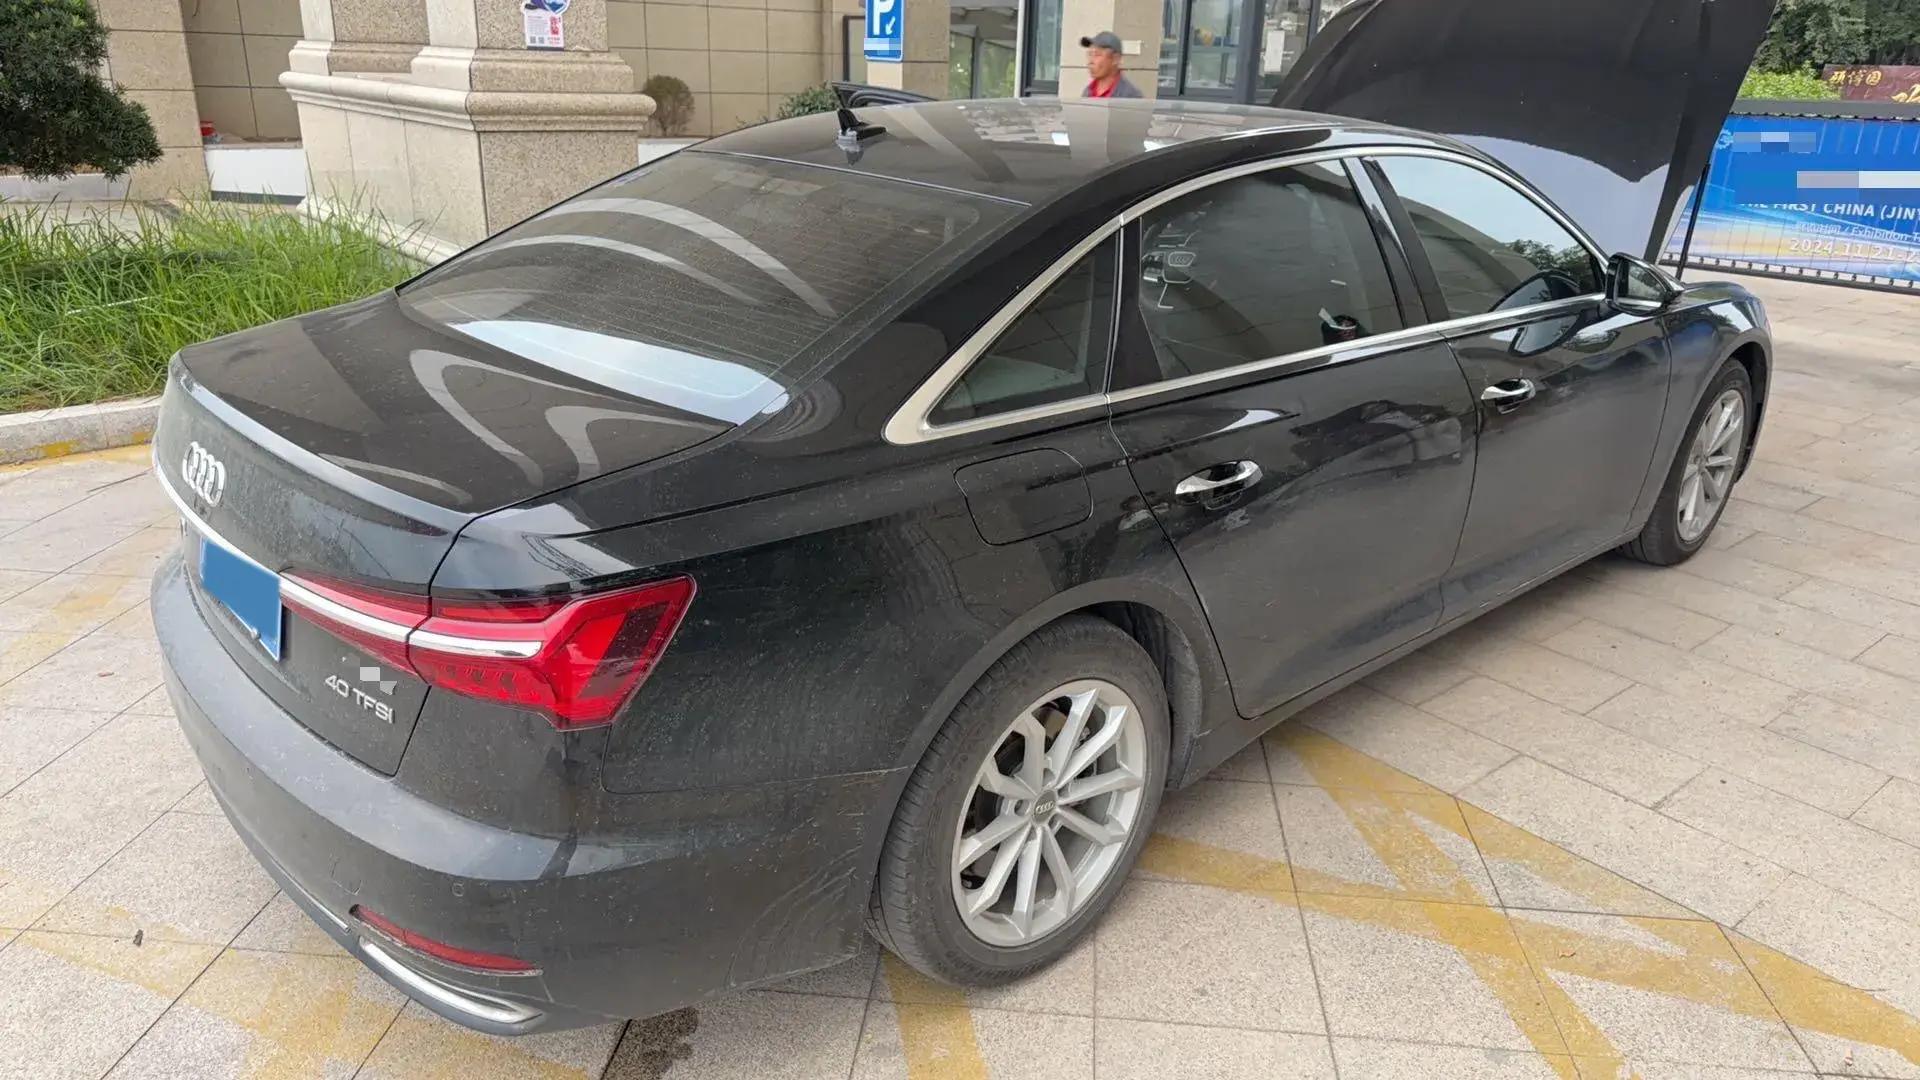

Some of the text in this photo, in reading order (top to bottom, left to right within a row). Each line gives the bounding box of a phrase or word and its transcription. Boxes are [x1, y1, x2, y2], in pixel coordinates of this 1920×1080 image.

[873, 0, 895, 35] P
[1823, 203, 1876, 217] CHINA
[1880, 203, 1920, 221] (JIN
[325, 675, 394, 724] 40 TFSI
